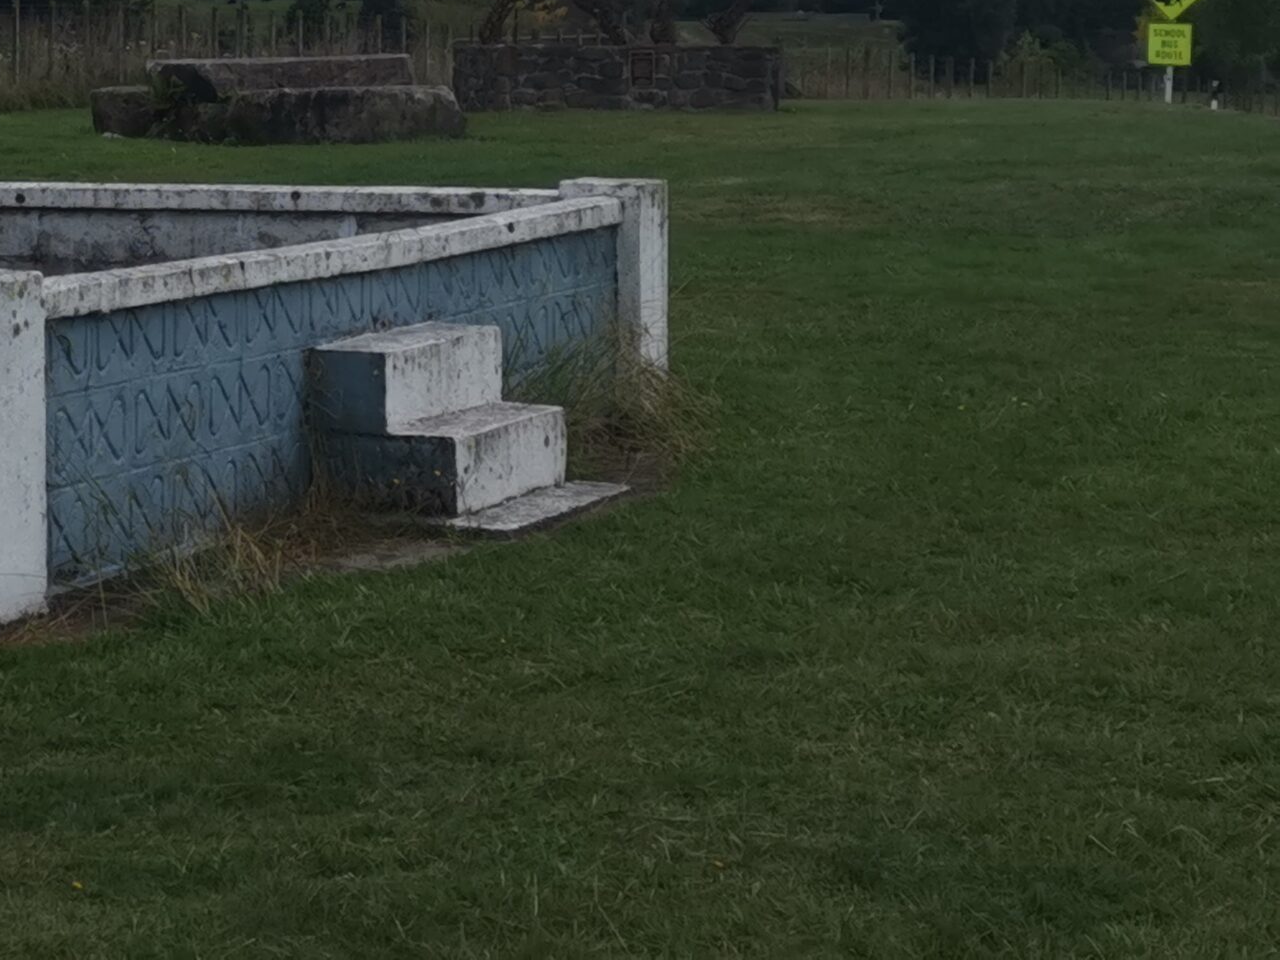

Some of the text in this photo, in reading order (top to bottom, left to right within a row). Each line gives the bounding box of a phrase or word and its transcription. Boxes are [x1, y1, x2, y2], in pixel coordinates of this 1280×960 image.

[1153, 28, 1186, 38] SCHOOL
[1161, 40, 1178, 49] BUS
[1155, 50, 1183, 60] ROUTE
